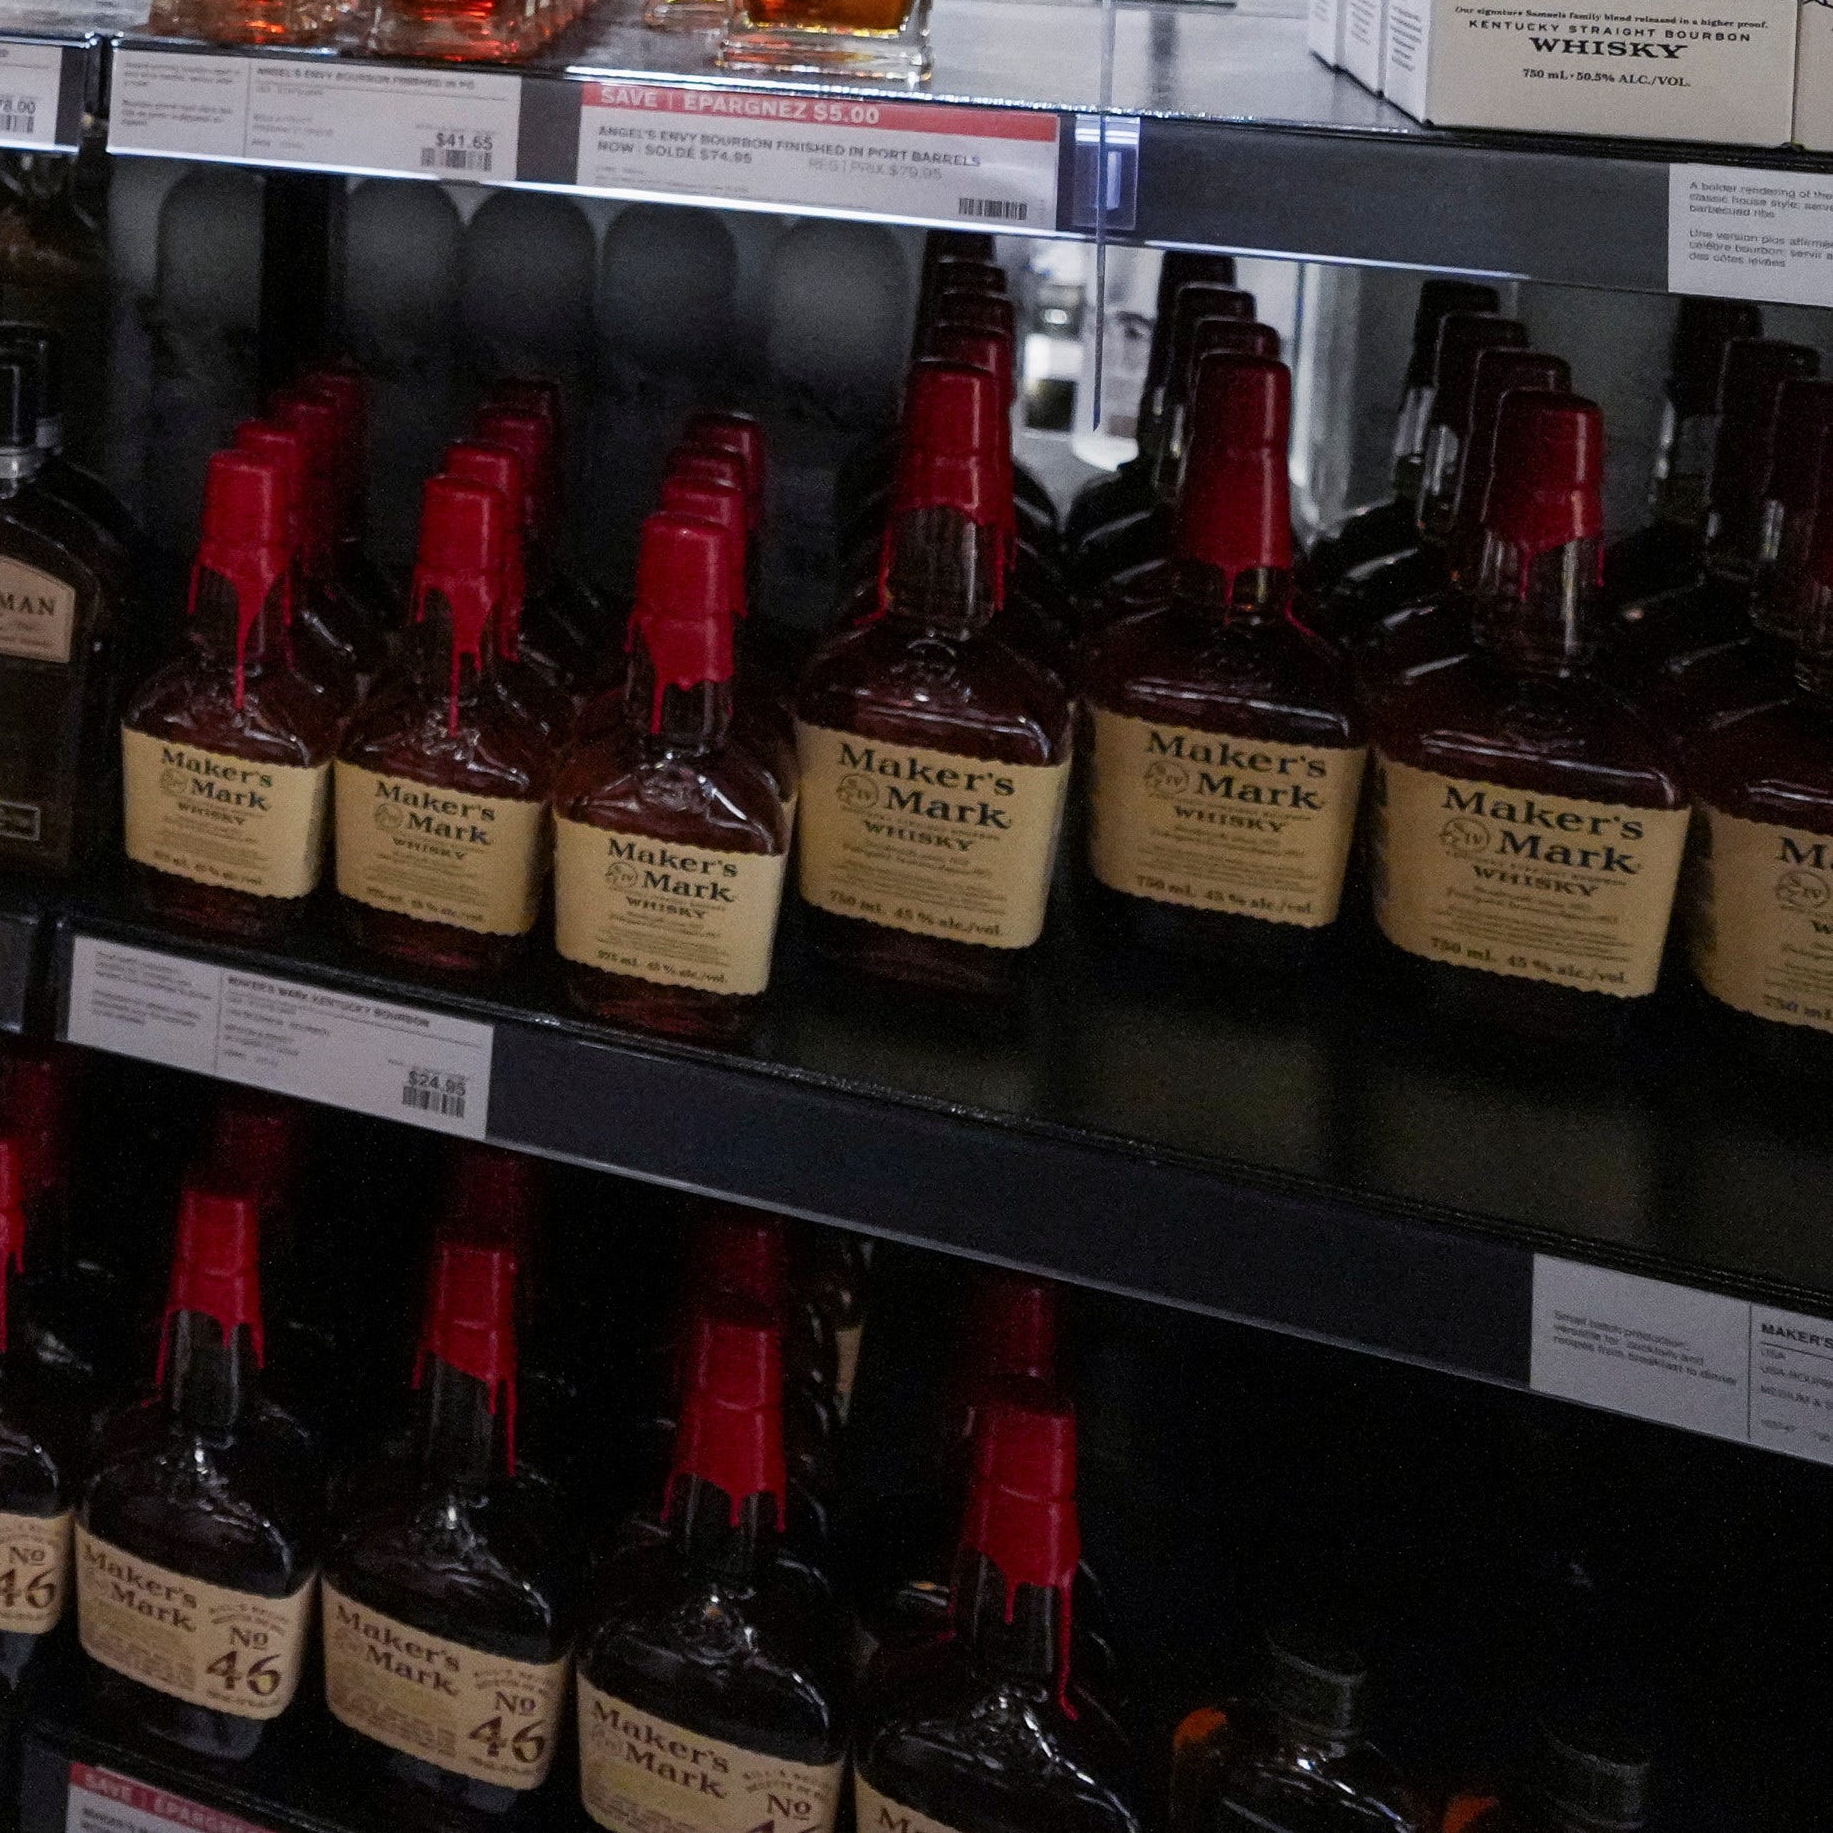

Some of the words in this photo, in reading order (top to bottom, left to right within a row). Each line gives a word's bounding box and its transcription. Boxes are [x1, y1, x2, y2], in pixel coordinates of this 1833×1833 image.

[1469, 19, 1559, 33] KENTUCKY
[1569, 24, 1657, 38] STRAIGHT
[1665, 29, 1752, 42] BOURBON
[1528, 36, 1689, 59] WHISKY
[600, 87, 658, 109] SAVE
[812, 103, 881, 125] $5.00
[659, 128, 697, 144] ENVY
[701, 132, 773, 149] BOURBON
[776, 139, 845, 156] FINISHED
[867, 146, 908, 162] PORT
[911, 150, 982, 167] BARRELS
[160, 746, 273, 788] Maker's
[838, 742, 1016, 797] Maker's
[1145, 730, 1327, 779] Maker's
[191, 777, 271, 812] Mark
[375, 779, 496, 822] Maker's
[884, 785, 1012, 831] Mark
[1196, 771, 1324, 811] Mark
[408, 811, 494, 846] Mark
[1440, 784, 1645, 841] Maker's
[607, 837, 738, 878] Maker's
[1495, 829, 1642, 876] Mark
[641, 869, 736, 903] Mark
[1760, 1322, 1833, 1350] MAKER'S
[110, 1580, 197, 1633] Mark
[205, 1650, 282, 1697] 46
[364, 1644, 460, 1698] Mark
[466, 1716, 547, 1764] 46
[623, 1741, 728, 1800] Mark
